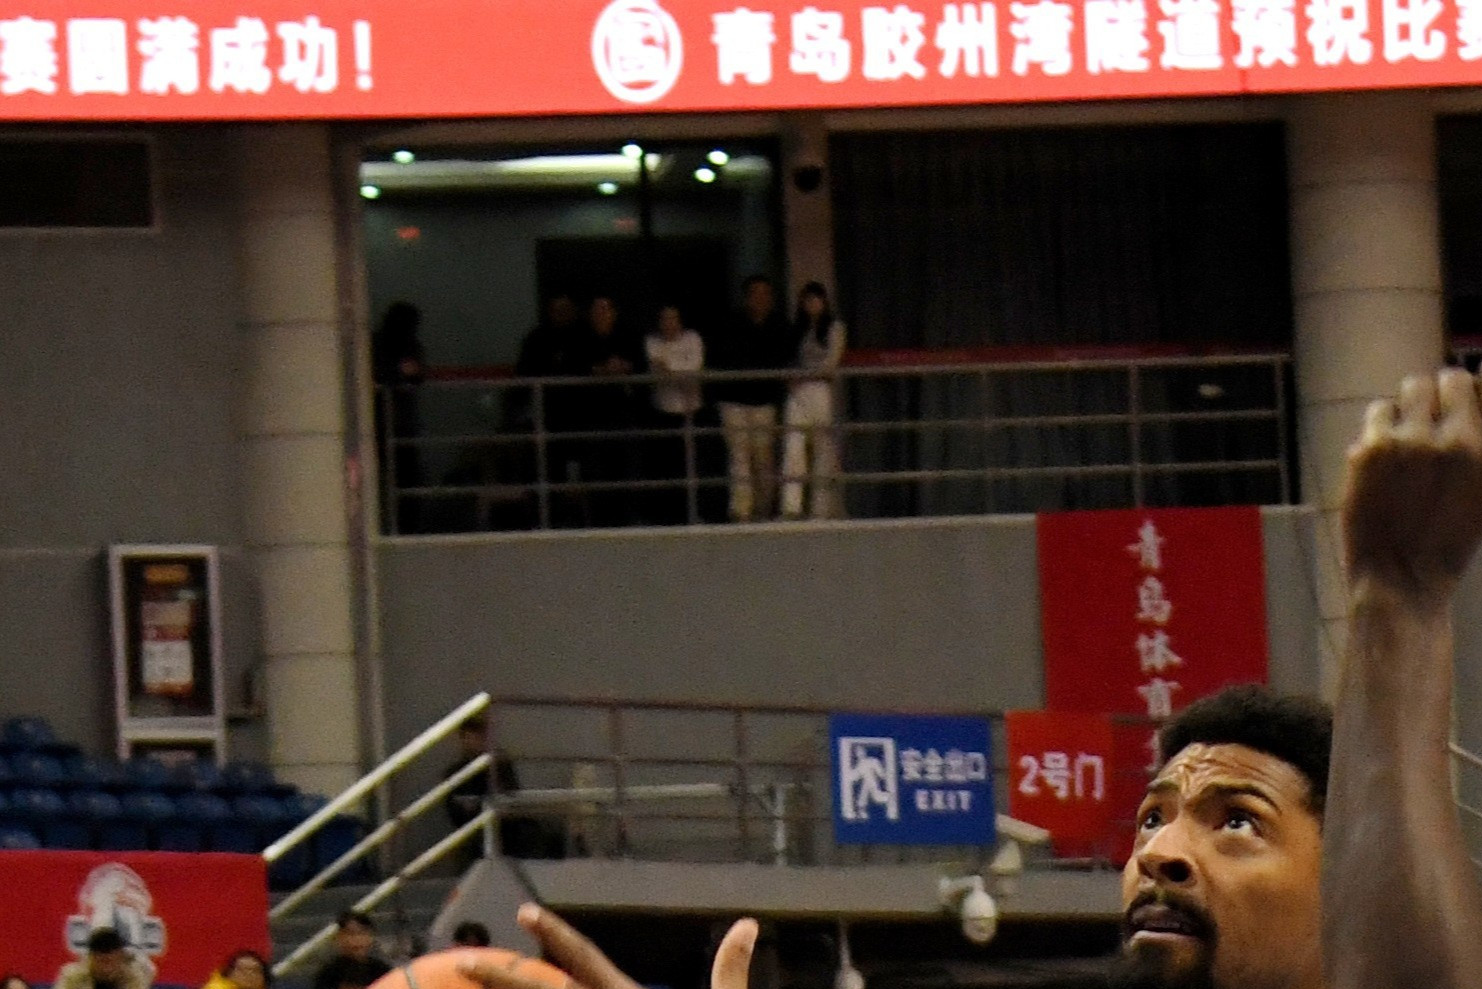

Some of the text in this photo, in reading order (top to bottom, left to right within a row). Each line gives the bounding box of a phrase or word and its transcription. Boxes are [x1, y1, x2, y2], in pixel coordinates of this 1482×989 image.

[901, 748, 987, 783] 安全出口
[1018, 751, 1105, 800] 2号门
[916, 789, 972, 811] EXIT
